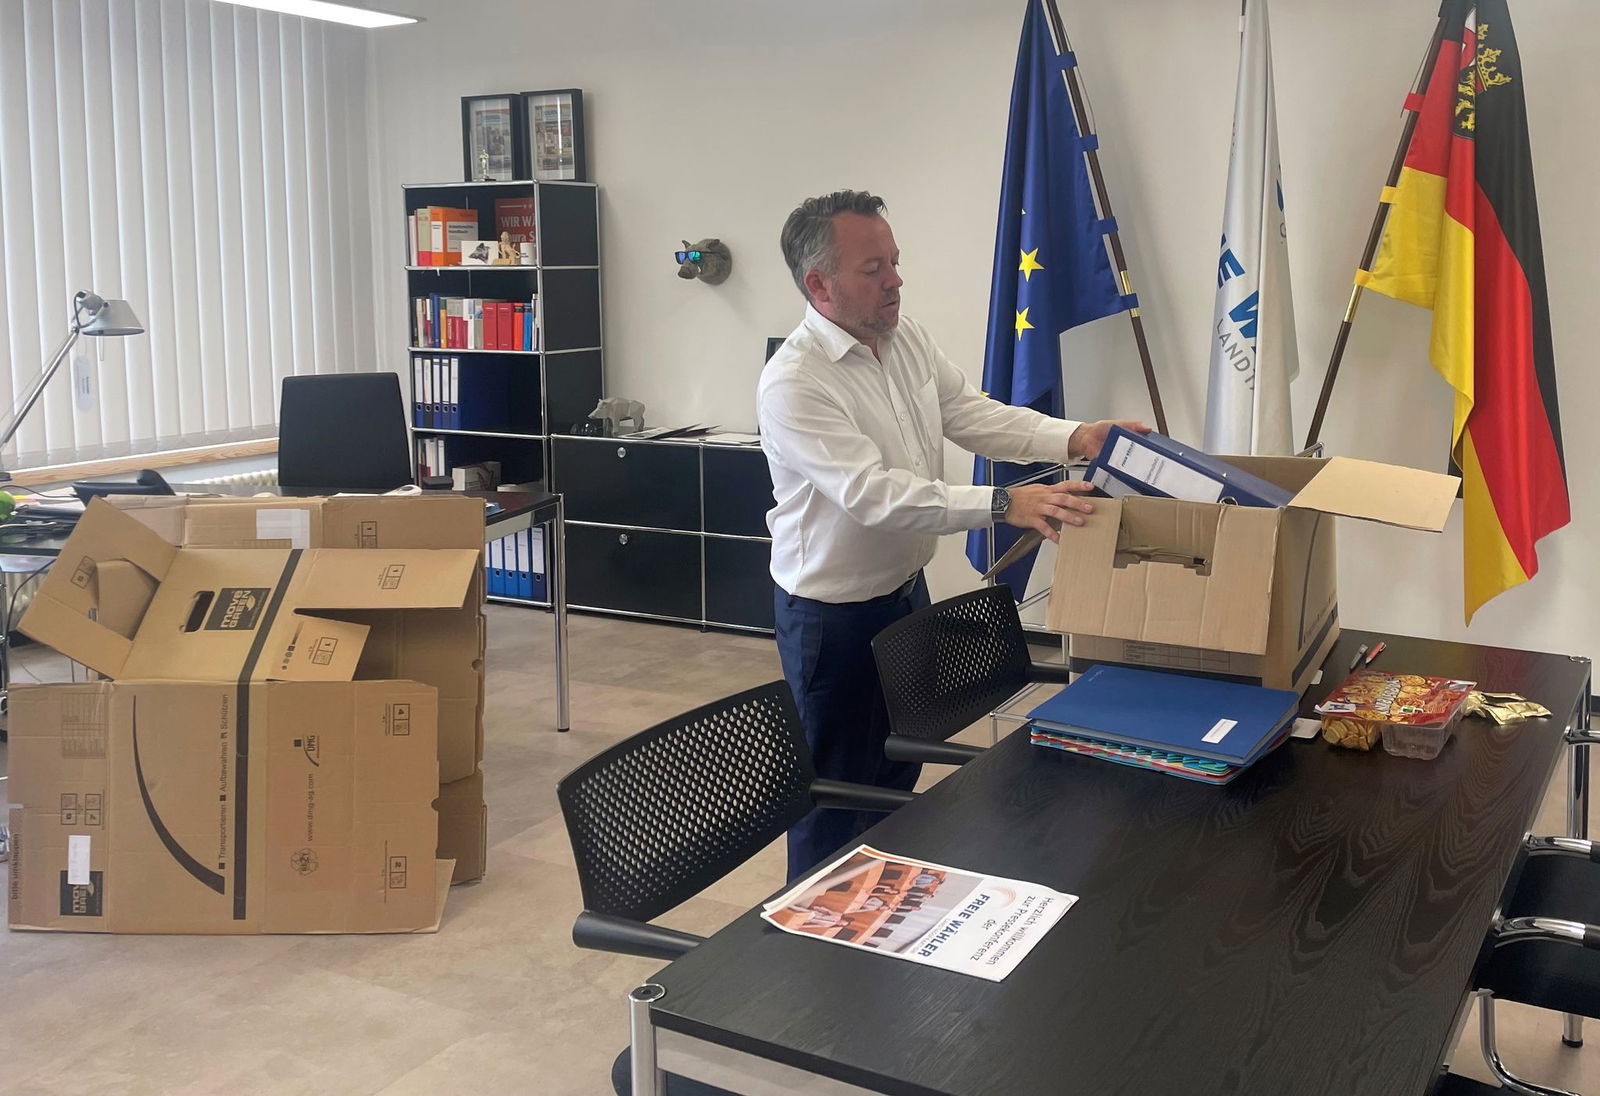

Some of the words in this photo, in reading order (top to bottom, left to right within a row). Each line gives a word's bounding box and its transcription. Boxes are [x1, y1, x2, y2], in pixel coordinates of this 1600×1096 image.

[501, 216, 520, 227] WIR
[220, 694, 228, 730] Schützen
[306, 735, 316, 752] DMG
[219, 742, 228, 792] Aufbewahren
[306, 774, 315, 842] www.dmg-ag.com
[218, 804, 228, 859] Transportieren
[959, 894, 990, 920] FREIE
[1022, 894, 1036, 907] zur
[1024, 897, 1054, 928] Herzlich
[918, 919, 963, 959] WÄHLER
[970, 907, 1027, 961] Pressekonferenz
[982, 918, 996, 930] der
[986, 926, 1028, 967] willkommen
